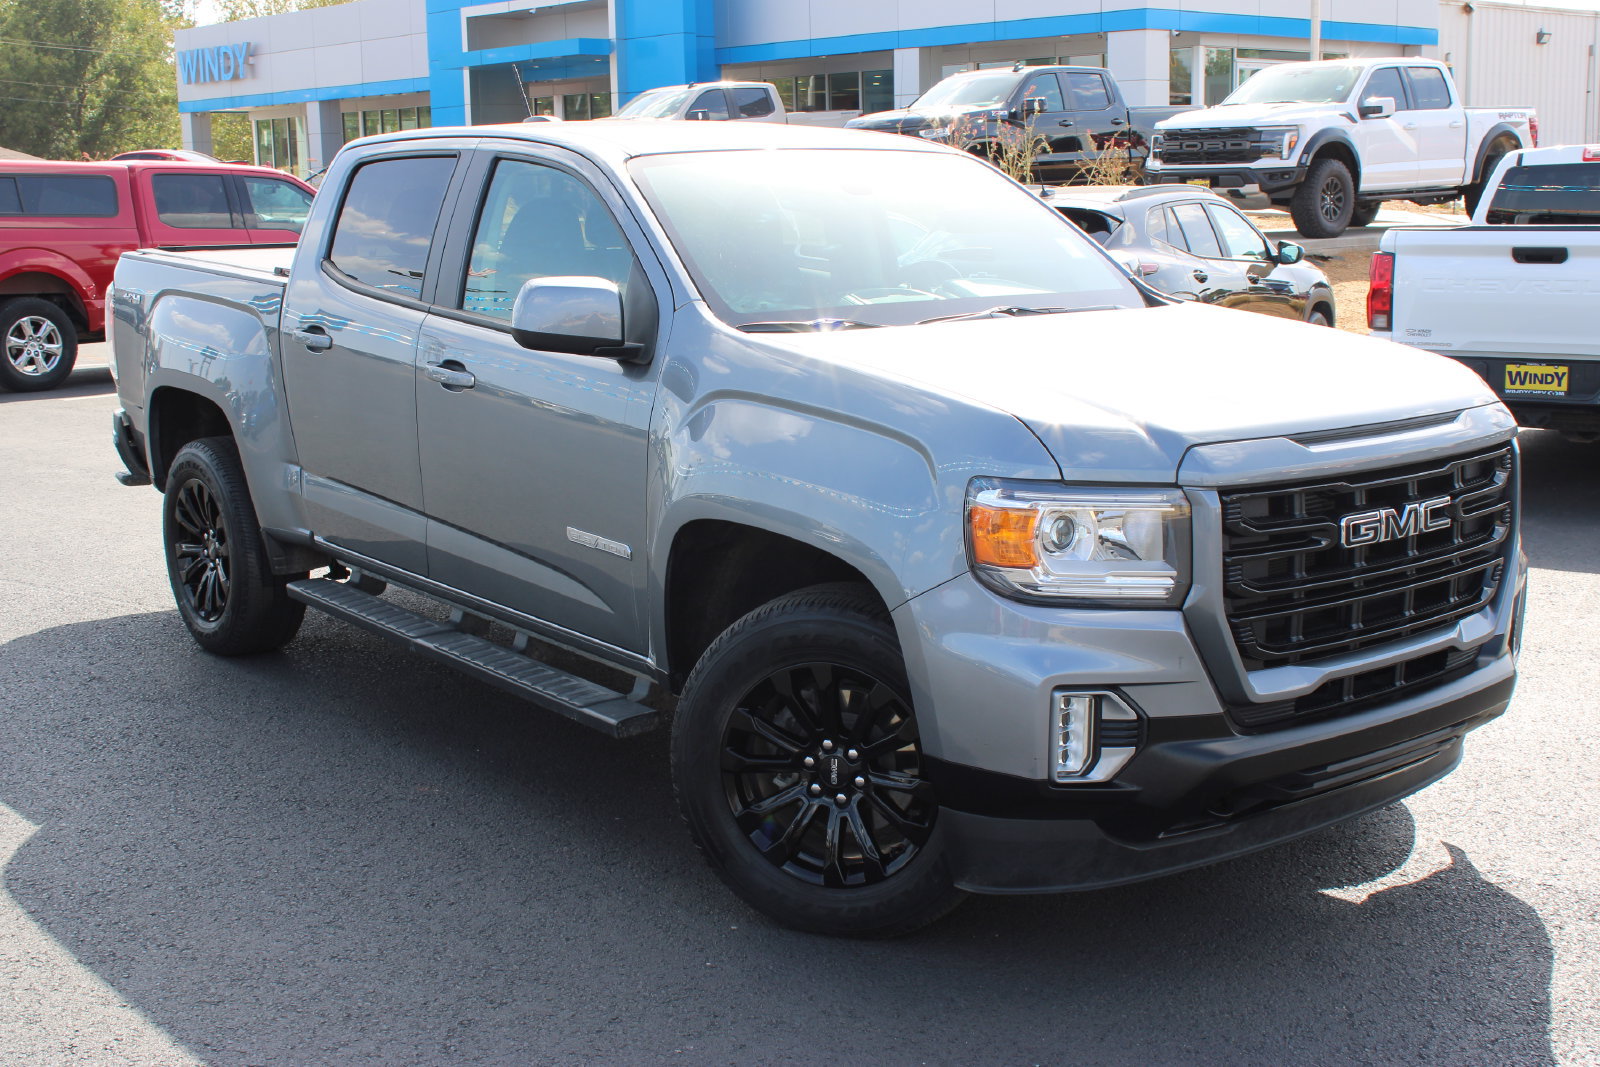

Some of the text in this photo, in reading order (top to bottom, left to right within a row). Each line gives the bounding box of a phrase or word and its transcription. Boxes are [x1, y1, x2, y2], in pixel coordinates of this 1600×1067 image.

[177, 42, 249, 85] WINDY
[1163, 141, 1251, 153] FORD
[1506, 370, 1567, 388] WINDY
[1340, 495, 1452, 548] GMC
